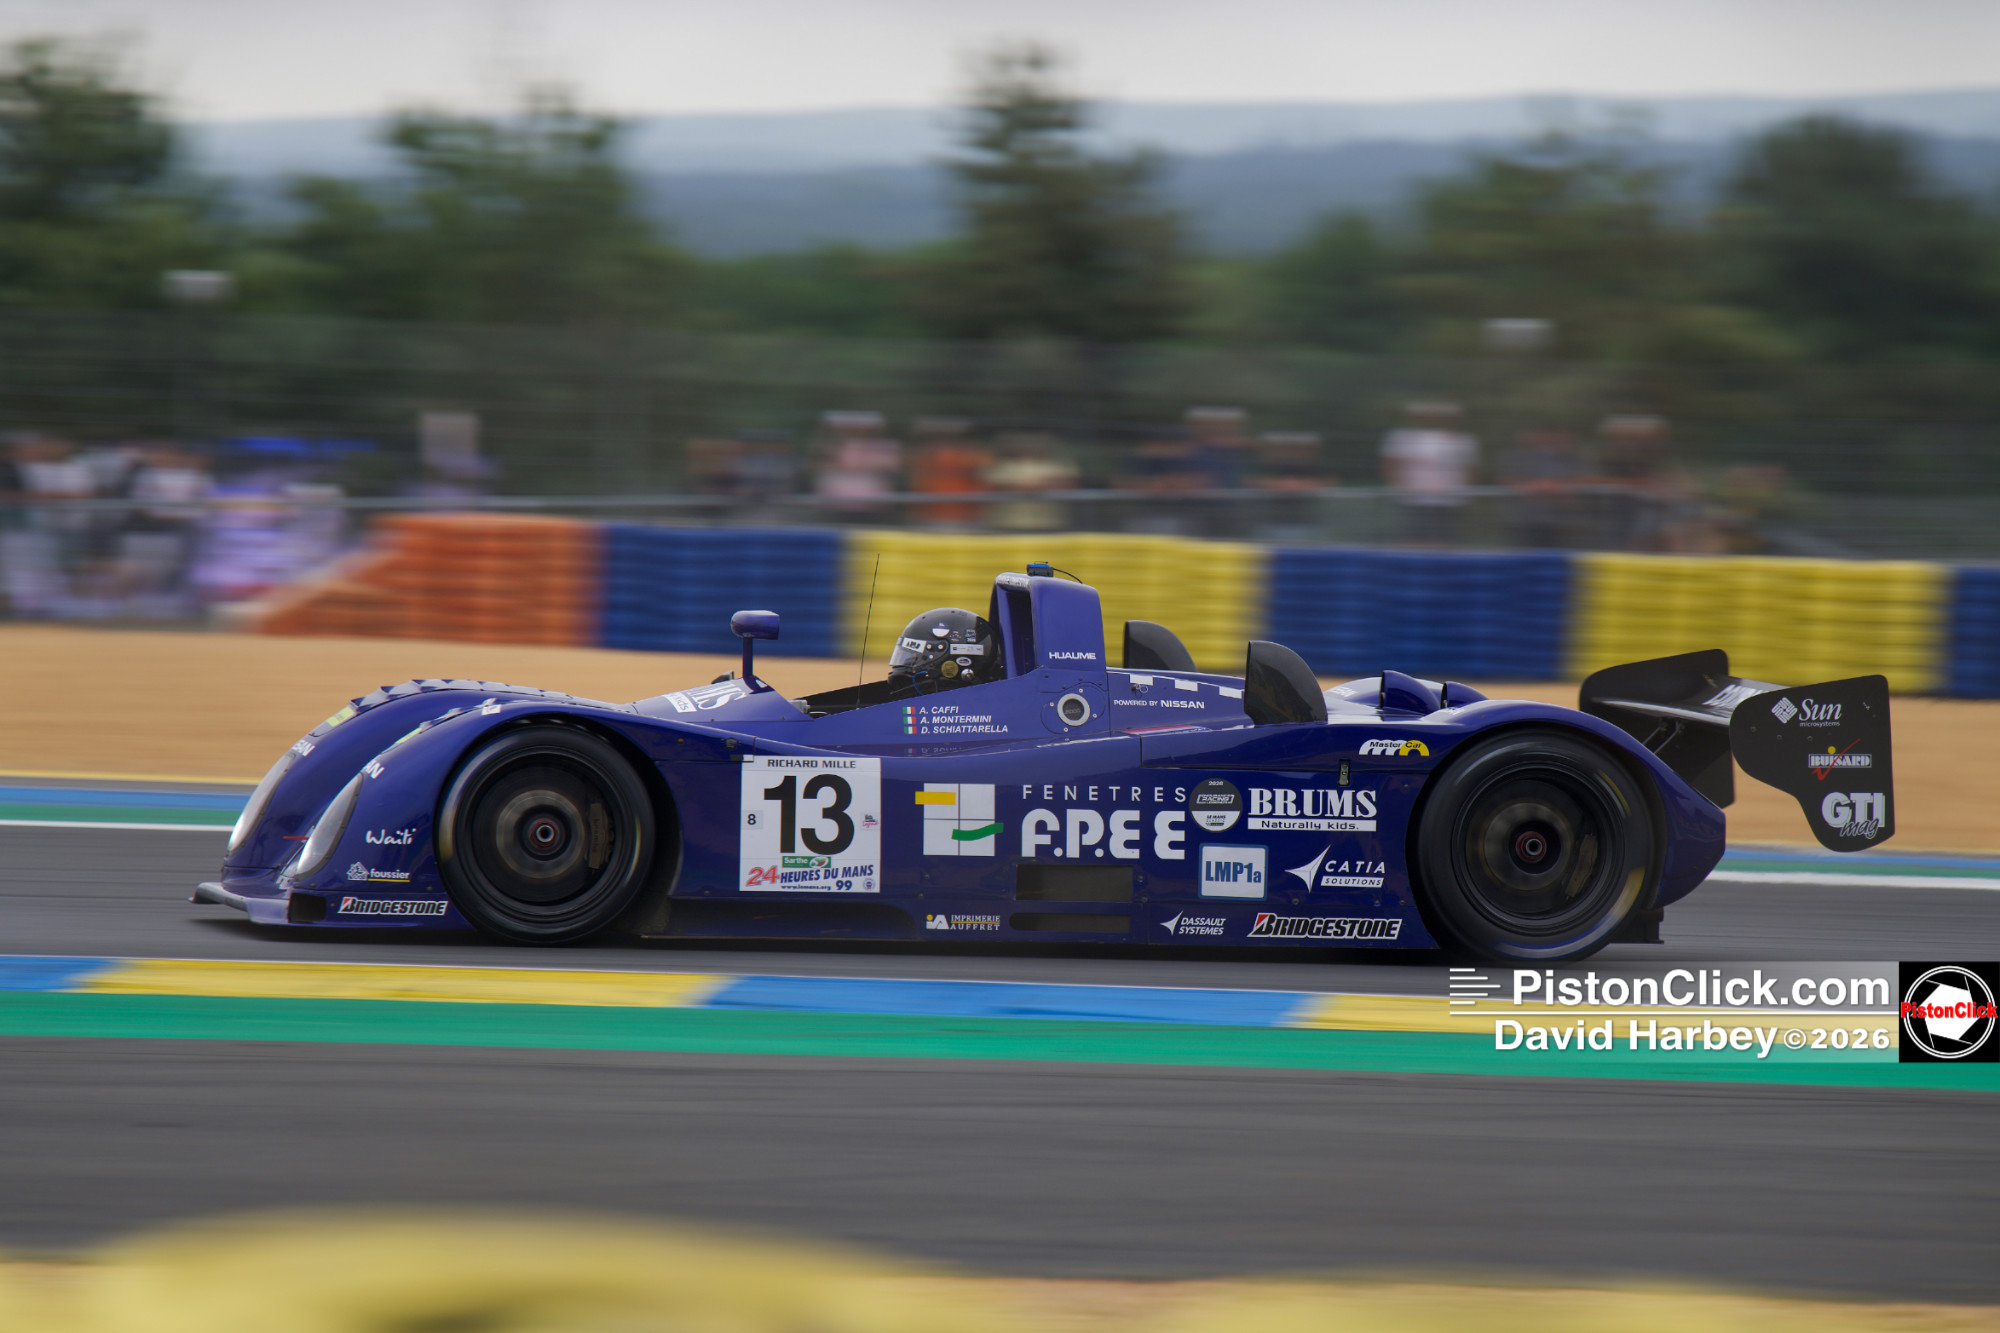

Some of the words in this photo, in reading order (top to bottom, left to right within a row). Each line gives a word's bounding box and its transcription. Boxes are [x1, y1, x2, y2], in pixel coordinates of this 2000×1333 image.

[1049, 652, 1097, 660] HUAUME
[919, 706, 929, 714] A.
[931, 706, 959, 714] CAFFI
[1160, 700, 1205, 709] NISSAN
[1799, 698, 1842, 721] Sun
[920, 716, 930, 724] A.
[932, 715, 992, 724] MONTERMINI
[921, 726, 931, 734] D.
[933, 725, 1008, 734] SCHIATTARELLA
[767, 759, 818, 768] RICHARD
[822, 760, 856, 769] MILLE
[1022, 784, 1187, 803] FENETRES
[1248, 787, 1377, 818] BRUMS
[764, 773, 855, 855] 13
[1822, 792, 1885, 828] GTI
[747, 813, 757, 825] 8
[1261, 820, 1322, 830] Naturally
[1327, 820, 1359, 830] kids.
[1840, 817, 1879, 839] mag
[1205, 861, 1262, 883] LMP1a
[1325, 860, 1386, 874] CATIA
[370, 868, 410, 879] foussier
[746, 865, 780, 887] 24
[780, 869, 821, 883] HEURES
[823, 867, 839, 880] DU
[841, 864, 874, 878] MANS
[836, 880, 853, 891] 99
[1325, 877, 1382, 886] SOLUTIONS
[338, 897, 448, 916] BRIDGESTONE
[951, 914, 1000, 922] IMPRIMERIE
[1180, 917, 1227, 926] DASSAULT
[950, 923, 1000, 931] AUFFRET
[1178, 926, 1224, 935] SYSTEMES
[1247, 913, 1402, 940] BRIDGESTONE
